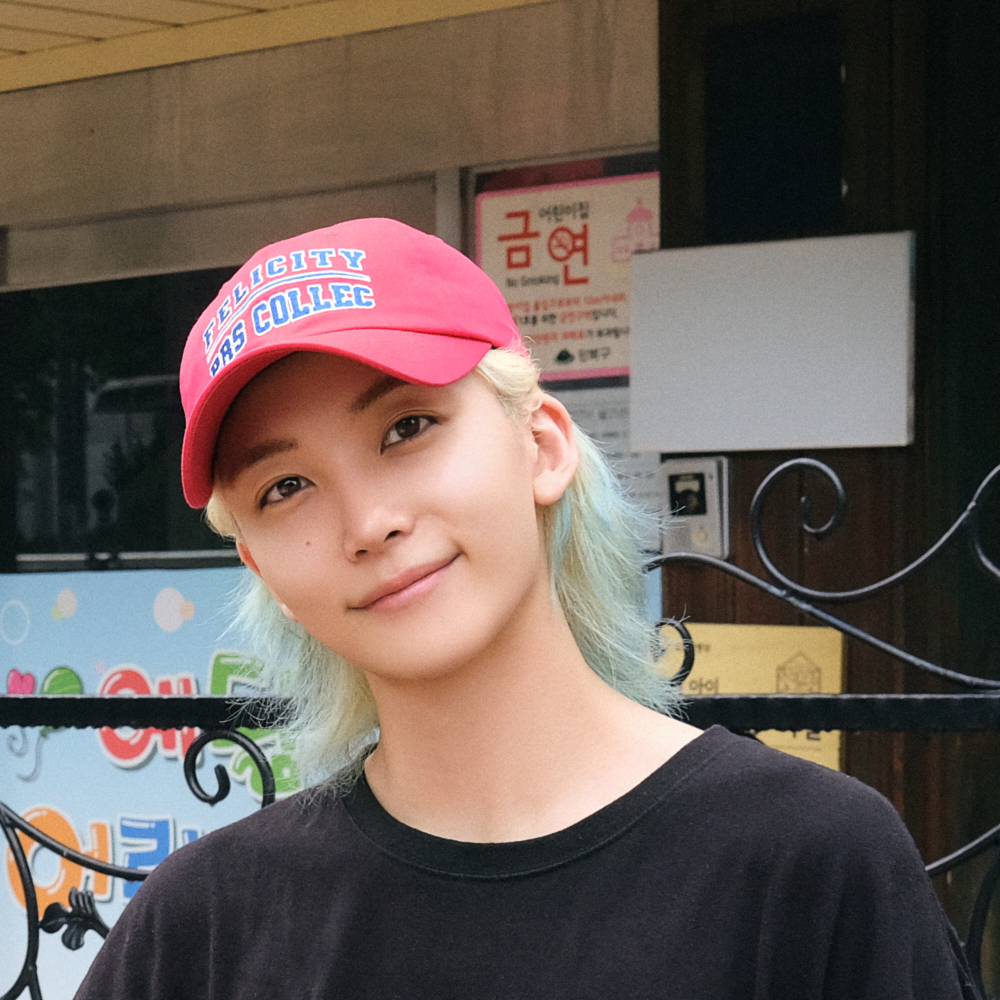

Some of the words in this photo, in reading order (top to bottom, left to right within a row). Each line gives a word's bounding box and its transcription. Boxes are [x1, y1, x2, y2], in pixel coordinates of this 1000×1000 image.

[498, 209, 590, 287] 금연
[202, 248, 367, 355] FELICITY
[252, 281, 376, 337] COLLEC
